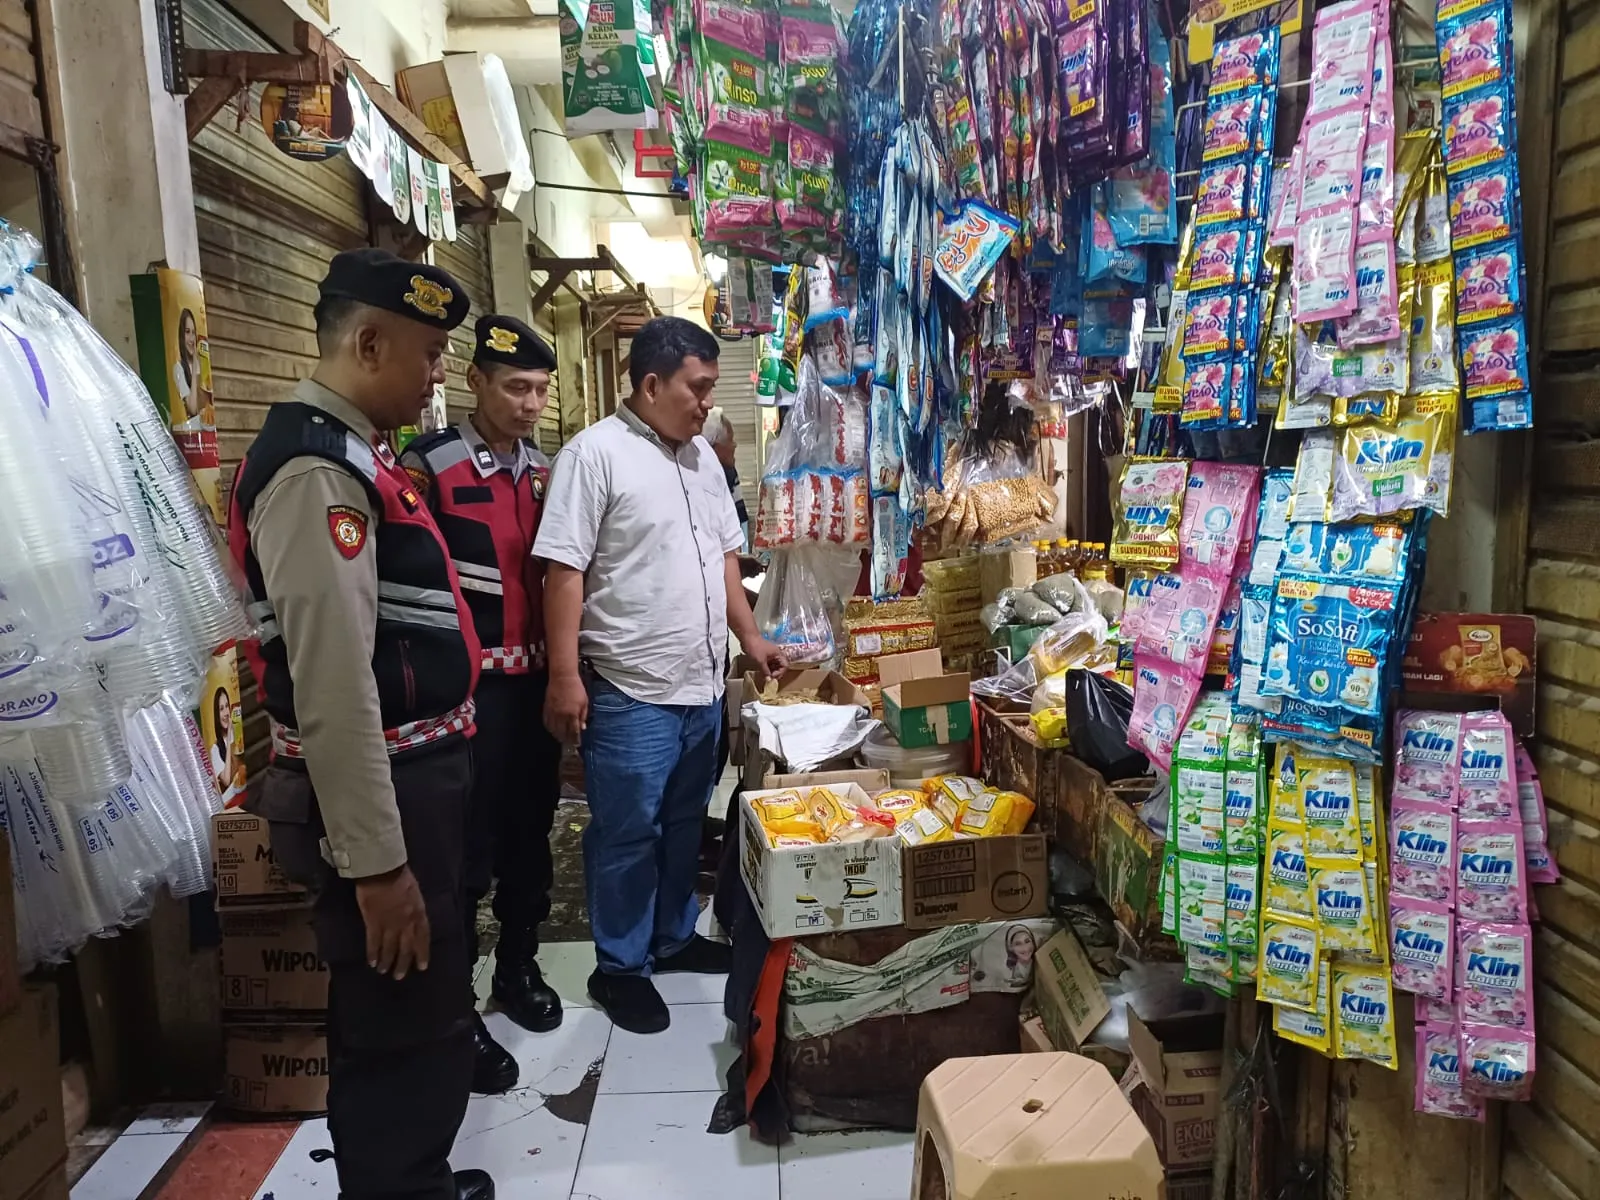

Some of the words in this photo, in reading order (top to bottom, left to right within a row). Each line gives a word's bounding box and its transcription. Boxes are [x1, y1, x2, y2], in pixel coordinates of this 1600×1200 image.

[590, 4, 615, 23] SUN
[592, 26, 614, 34] KRIM
[724, 78, 758, 105] Rinso
[1357, 266, 1386, 284] lin
[1457, 276, 1509, 303] Royale
[1465, 351, 1517, 377] Royale
[1356, 436, 1425, 465] Klin
[1188, 477, 1204, 489] lin
[150, 483, 180, 522] QUALITY
[1125, 505, 1171, 526] Klin
[1154, 574, 1182, 590] Klin
[1298, 617, 1359, 643] SoSoft
[1347, 655, 1376, 665] GRATIS
[1139, 669, 1160, 686] Klin
[1403, 729, 1454, 752] Klin
[1460, 769, 1500, 779] antai
[1227, 790, 1254, 809] lin
[1305, 791, 1350, 809] Klin
[1306, 809, 1349, 819] Lantai
[1397, 830, 1448, 854] Klin
[1398, 849, 1443, 864] Lantai
[1460, 853, 1513, 874] Klin
[221, 876, 234, 887] 10
[1227, 883, 1253, 902] lin
[1317, 889, 1362, 909] Klin
[1319, 907, 1361, 919] Lantai
[1394, 929, 1445, 954] Klin
[1266, 942, 1311, 965] Klin
[1395, 949, 1440, 963] Lantai
[1267, 957, 1307, 974] Lantai
[1468, 954, 1521, 977] Klin
[230, 978, 242, 998] 8
[1468, 973, 1518, 987] Lantai
[1340, 992, 1386, 1015] Klin
[1341, 1009, 1384, 1025] Lantai
[1471, 1059, 1523, 1081] Klin
